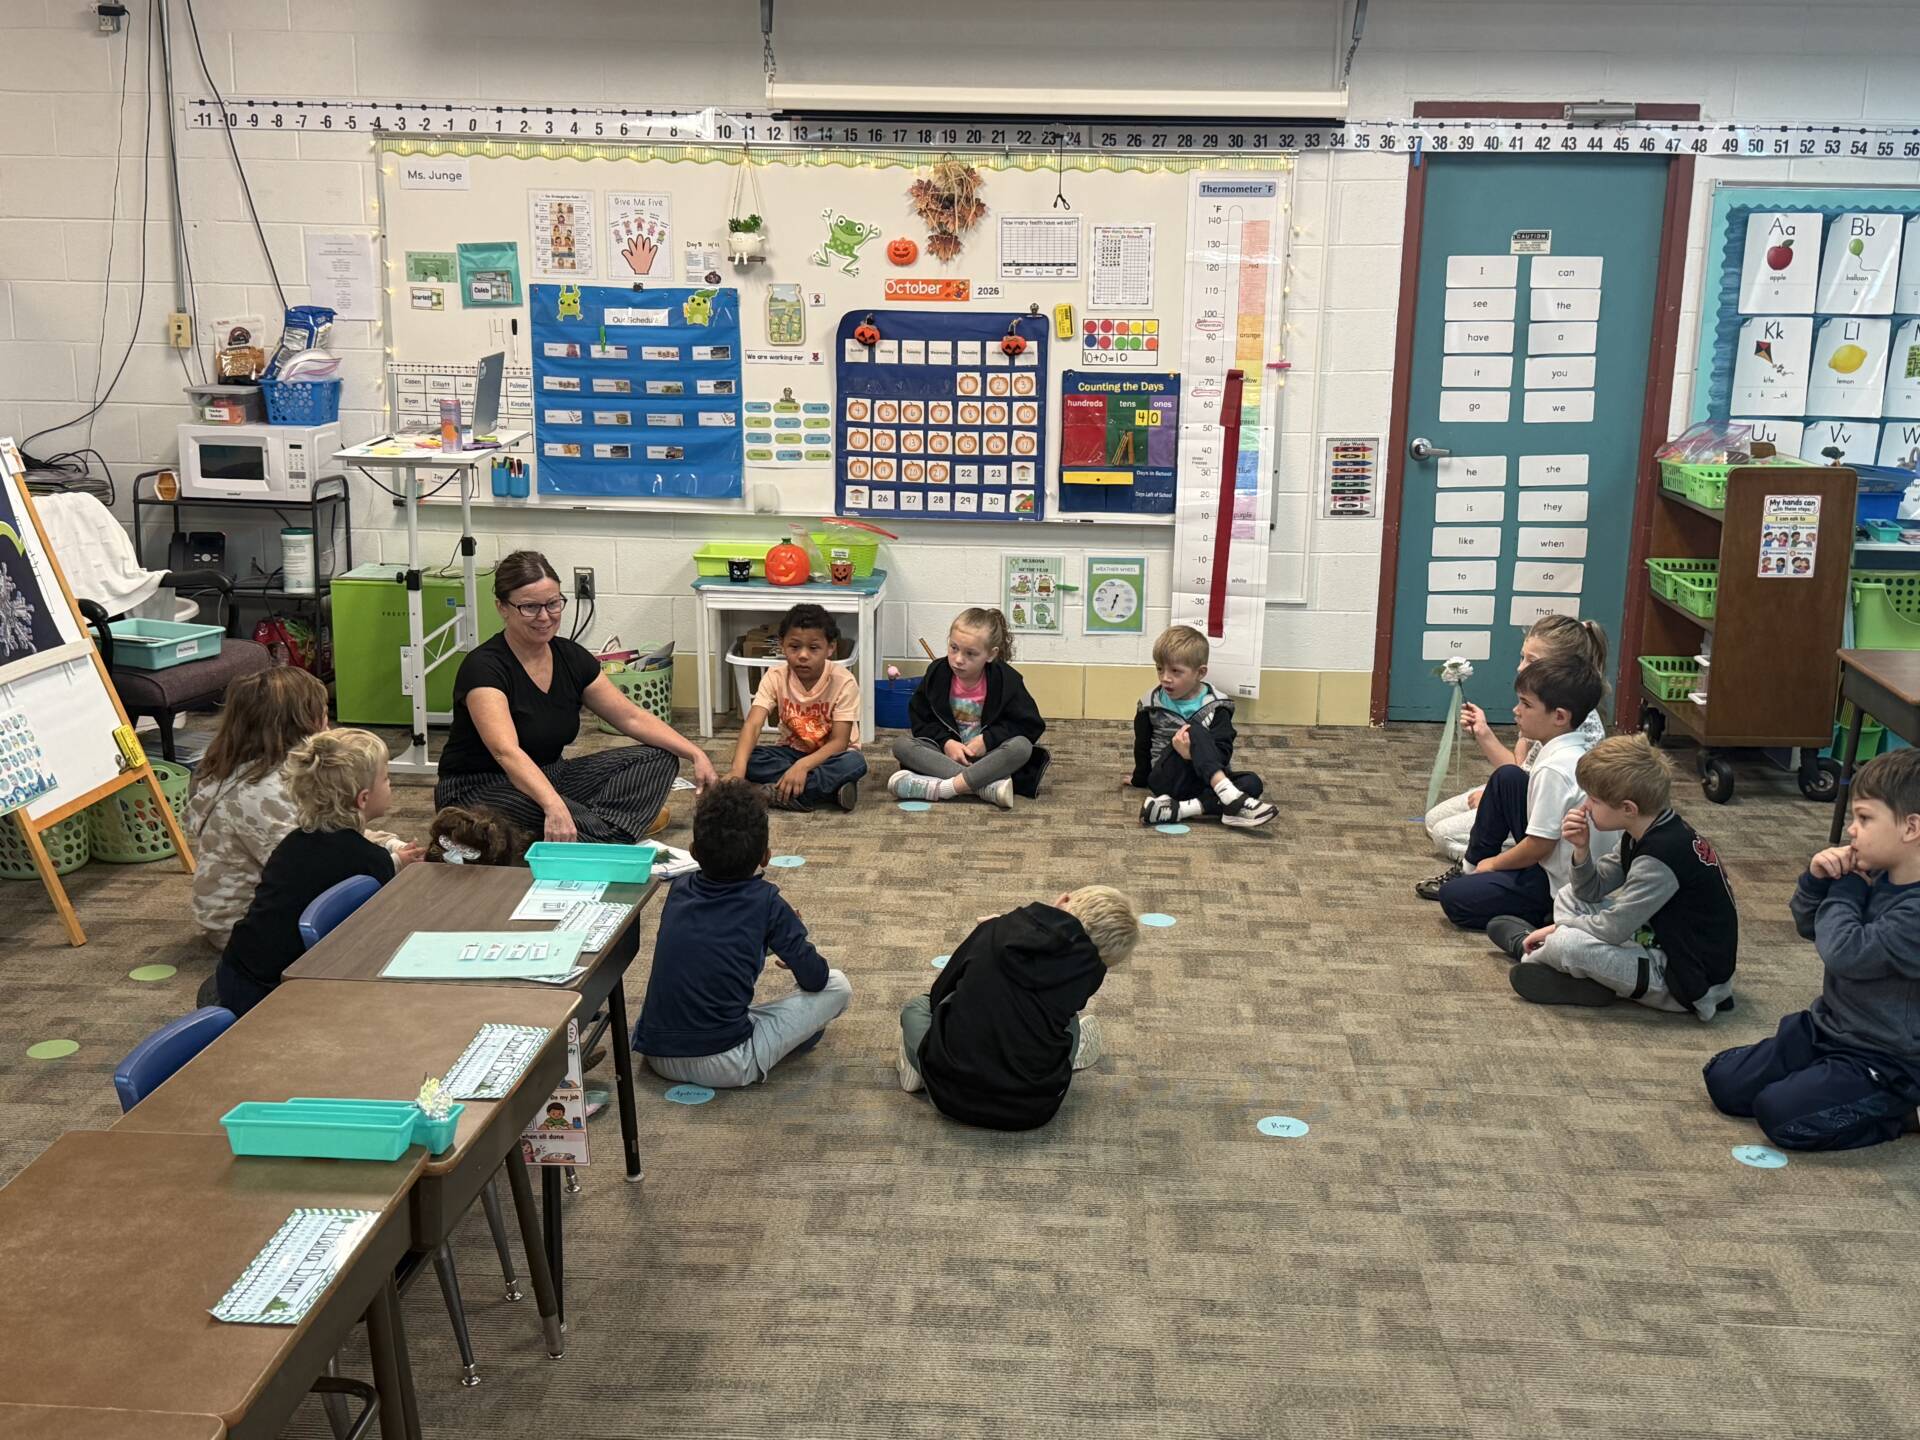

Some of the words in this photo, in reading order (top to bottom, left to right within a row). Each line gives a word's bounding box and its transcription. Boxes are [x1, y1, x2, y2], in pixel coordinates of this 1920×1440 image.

[194, 114, 211, 127] -11
[246, 115, 259, 127] -9
[270, 115, 283, 127] -8
[295, 115, 307, 127] -7
[320, 115, 332, 128] -6
[344, 115, 357, 129] -5
[394, 117, 406, 130] -3
[418, 118, 431, 131] -2
[443, 118, 454, 131] -1
[469, 118, 477, 132] 0
[496, 119, 501, 132] 1
[520, 120, 528, 133] 2
[545, 121, 553, 134] 3
[570, 121, 578, 134] 4
[595, 122, 603, 135] 5
[620, 122, 628, 136] 6
[717, 125, 732, 139] 10
[767, 126, 781, 140] 12
[1354, 134, 1370, 148] 35
[1379, 134, 1396, 149] 36
[1432, 136, 1448, 150] 38
[1458, 136, 1474, 150] 39
[1483, 136, 1499, 150] 40
[1509, 136, 1524, 150] 41
[1534, 136, 1551, 151] 42
[1560, 136, 1577, 151] 43
[1587, 137, 1603, 151] 44
[1613, 137, 1630, 151] 45
[1639, 138, 1655, 151] 46
[1665, 138, 1681, 152] 47
[1691, 139, 1707, 153] 48
[1722, 139, 1738, 153] 49
[1748, 139, 1764, 153] 50
[1774, 139, 1789, 153] 51
[1800, 140, 1816, 154] 52
[1824, 140, 1841, 154] 53
[1850, 141, 1868, 155] 54
[1877, 141, 1894, 156] 55
[1903, 142, 1920, 156] 56
[407, 170, 426, 181] Ms.
[428, 169, 462, 183] Junge
[1201, 185, 1262, 193] Thermometer
[614, 198, 631, 206] Give
[648, 198, 663, 206] Five
[1208, 216, 1222, 224] 140
[1768, 217, 1796, 236] Aa
[1850, 217, 1876, 237] Bb
[1207, 240, 1221, 248] 130
[1558, 269, 1575, 277] can
[1769, 274, 1786, 282] apple
[885, 280, 942, 294] October
[977, 287, 1000, 295] 2026
[1205, 287, 1219, 295] 110
[1472, 300, 1488, 308] see
[1556, 301, 1572, 310] the
[1204, 310, 1218, 318] 100
[1764, 321, 1784, 340] Kk
[1206, 333, 1217, 341] 90
[1239, 332, 1261, 340] orange
[1467, 333, 1489, 342] have
[769, 353, 792, 363] working
[1205, 356, 1216, 364] 80
[1473, 369, 1480, 377] it
[1551, 370, 1568, 379] you
[1763, 376, 1775, 384] kite
[1078, 382, 1121, 393] Counting
[1123, 382, 1138, 391] the
[1141, 382, 1164, 393] Days
[1067, 399, 1103, 408] hundreds
[1119, 400, 1137, 408] tens
[1203, 401, 1214, 409] 60
[1468, 403, 1481, 412] go
[1751, 423, 1777, 442] Uu
[1830, 423, 1852, 443] Vv
[1202, 447, 1212, 455] 40
[960, 469, 972, 477] 22
[1200, 469, 1211, 477] 30
[1466, 468, 1478, 476] he
[1546, 465, 1561, 473] she
[991, 469, 1002, 478] 23
[877, 494, 888, 502] 26
[1200, 490, 1210, 498] 20
[906, 495, 917, 504] 27
[933, 495, 944, 504] 28
[960, 496, 971, 505] 29
[988, 497, 999, 506] 30
[1466, 504, 1473, 512] is
[1543, 503, 1563, 512] they
[1201, 512, 1210, 520] 10
[1458, 537, 1475, 545] like
[1540, 540, 1565, 548] when
[1457, 572, 1467, 580] to
[1542, 573, 1554, 581] do
[1191, 577, 1206, 585] -20
[1452, 607, 1469, 615] this
[1535, 607, 1554, 616] that
[1450, 640, 1463, 649] for
